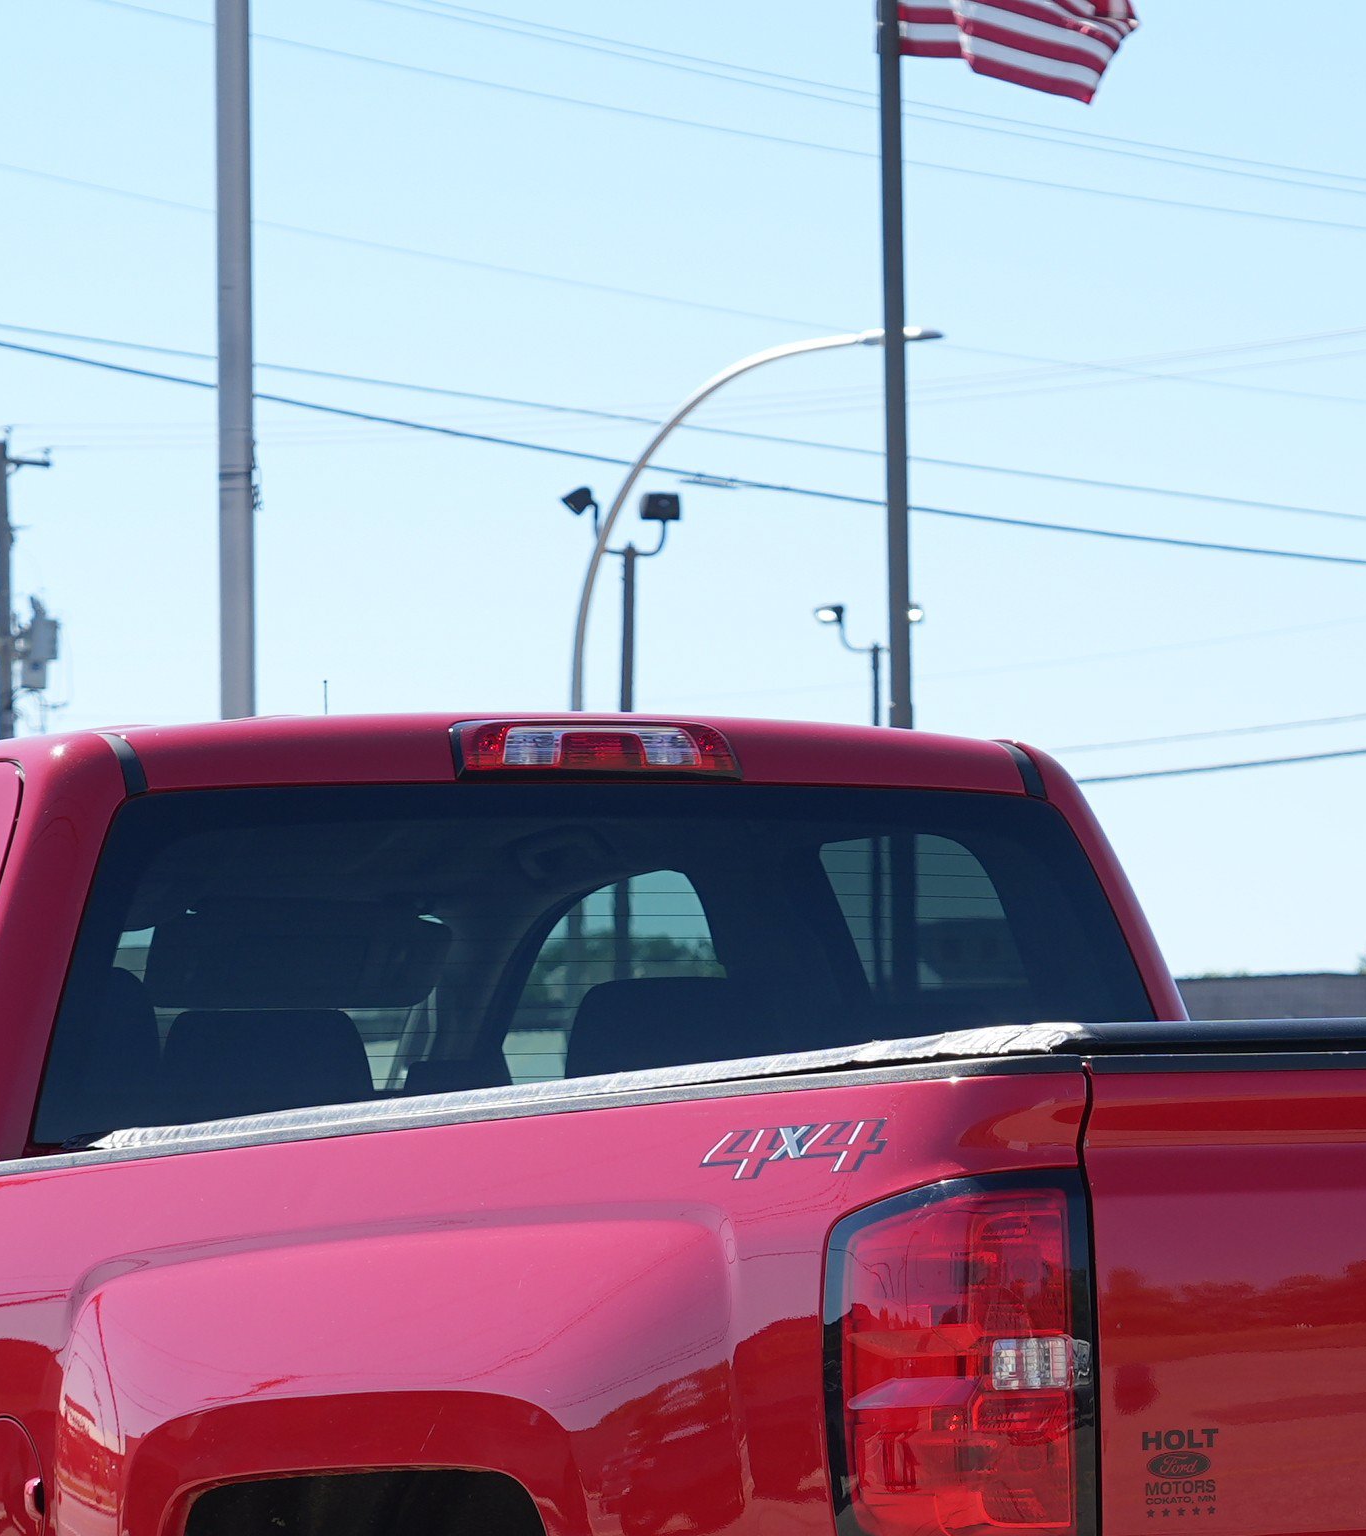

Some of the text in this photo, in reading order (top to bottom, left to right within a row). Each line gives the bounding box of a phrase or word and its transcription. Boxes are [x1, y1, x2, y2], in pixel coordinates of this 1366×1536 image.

[1141, 1428, 1219, 1451] HOLT
[1160, 1455, 1199, 1474] Ford
[1145, 1480, 1216, 1496] MOTORS
[1198, 1494, 1217, 1503] MN
